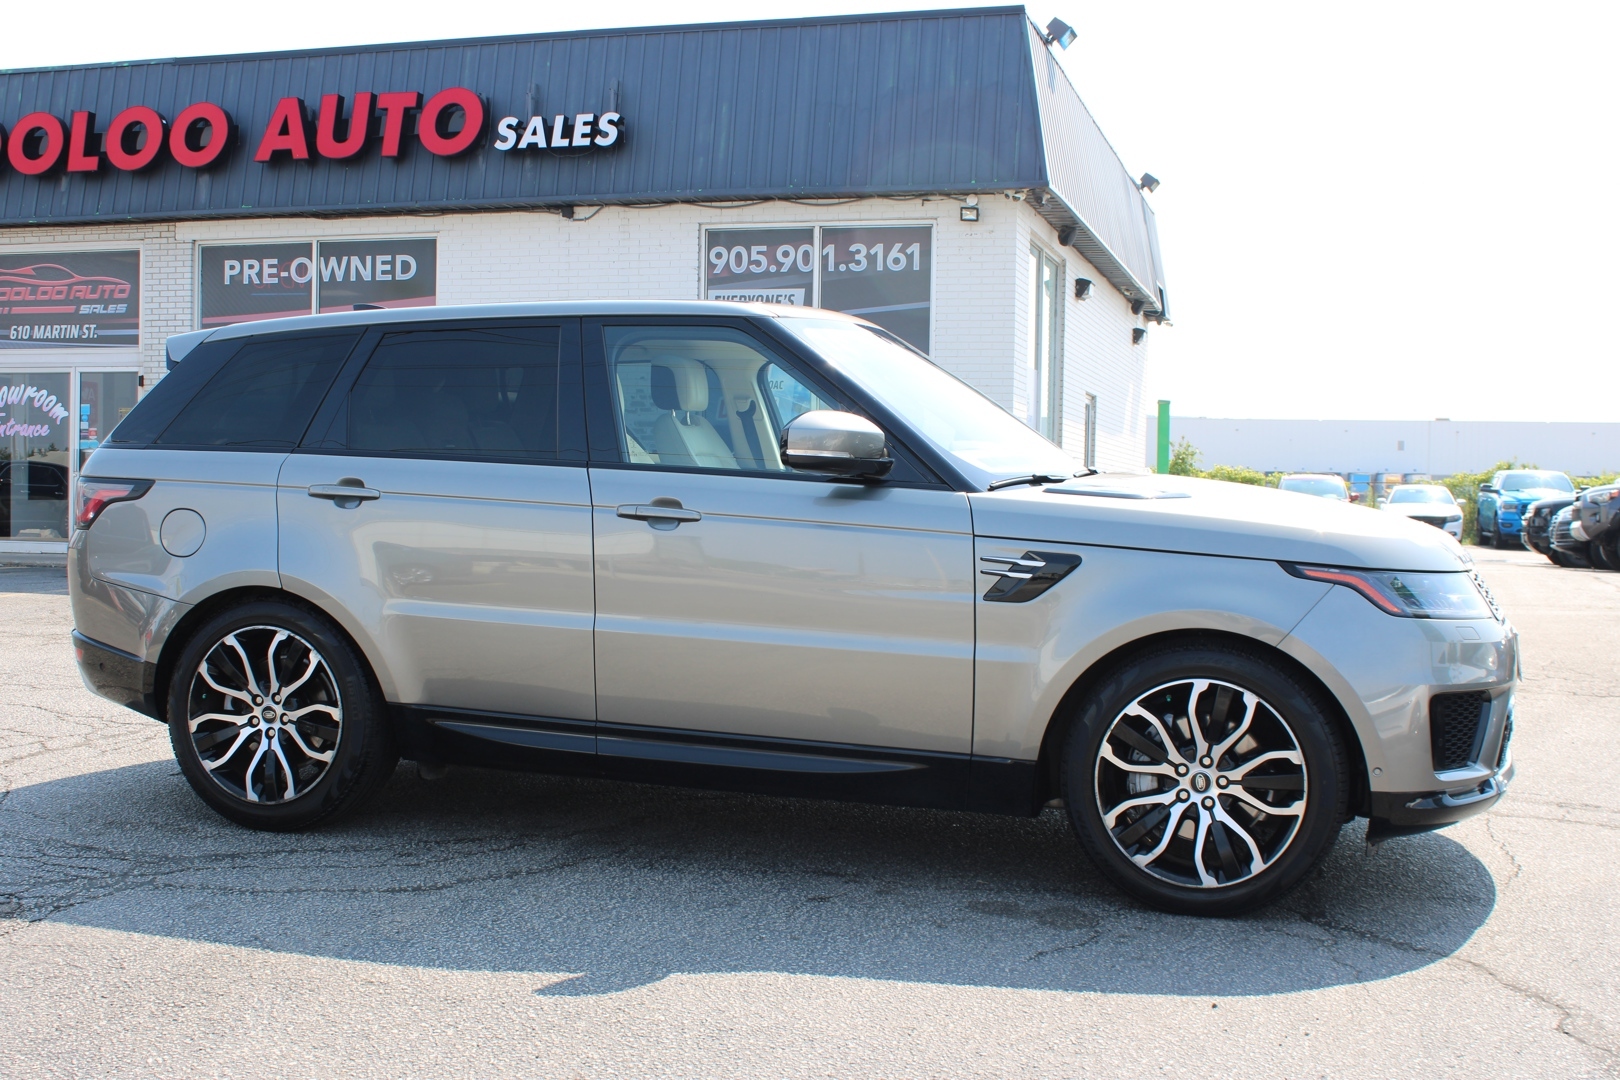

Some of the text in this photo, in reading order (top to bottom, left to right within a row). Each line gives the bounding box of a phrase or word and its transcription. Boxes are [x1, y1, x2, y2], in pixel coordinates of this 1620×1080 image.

[0, 87, 621, 176] OLOO AUTO SALES
[709, 242, 921, 274] 905.901.3161
[223, 254, 418, 286] PRE-OWNED
[69, 284, 131, 299] AUTO
[79, 304, 128, 315] SALES
[10, 324, 98, 340] 610 MARTIN ST.
[0, 415, 50, 438] ntrance
